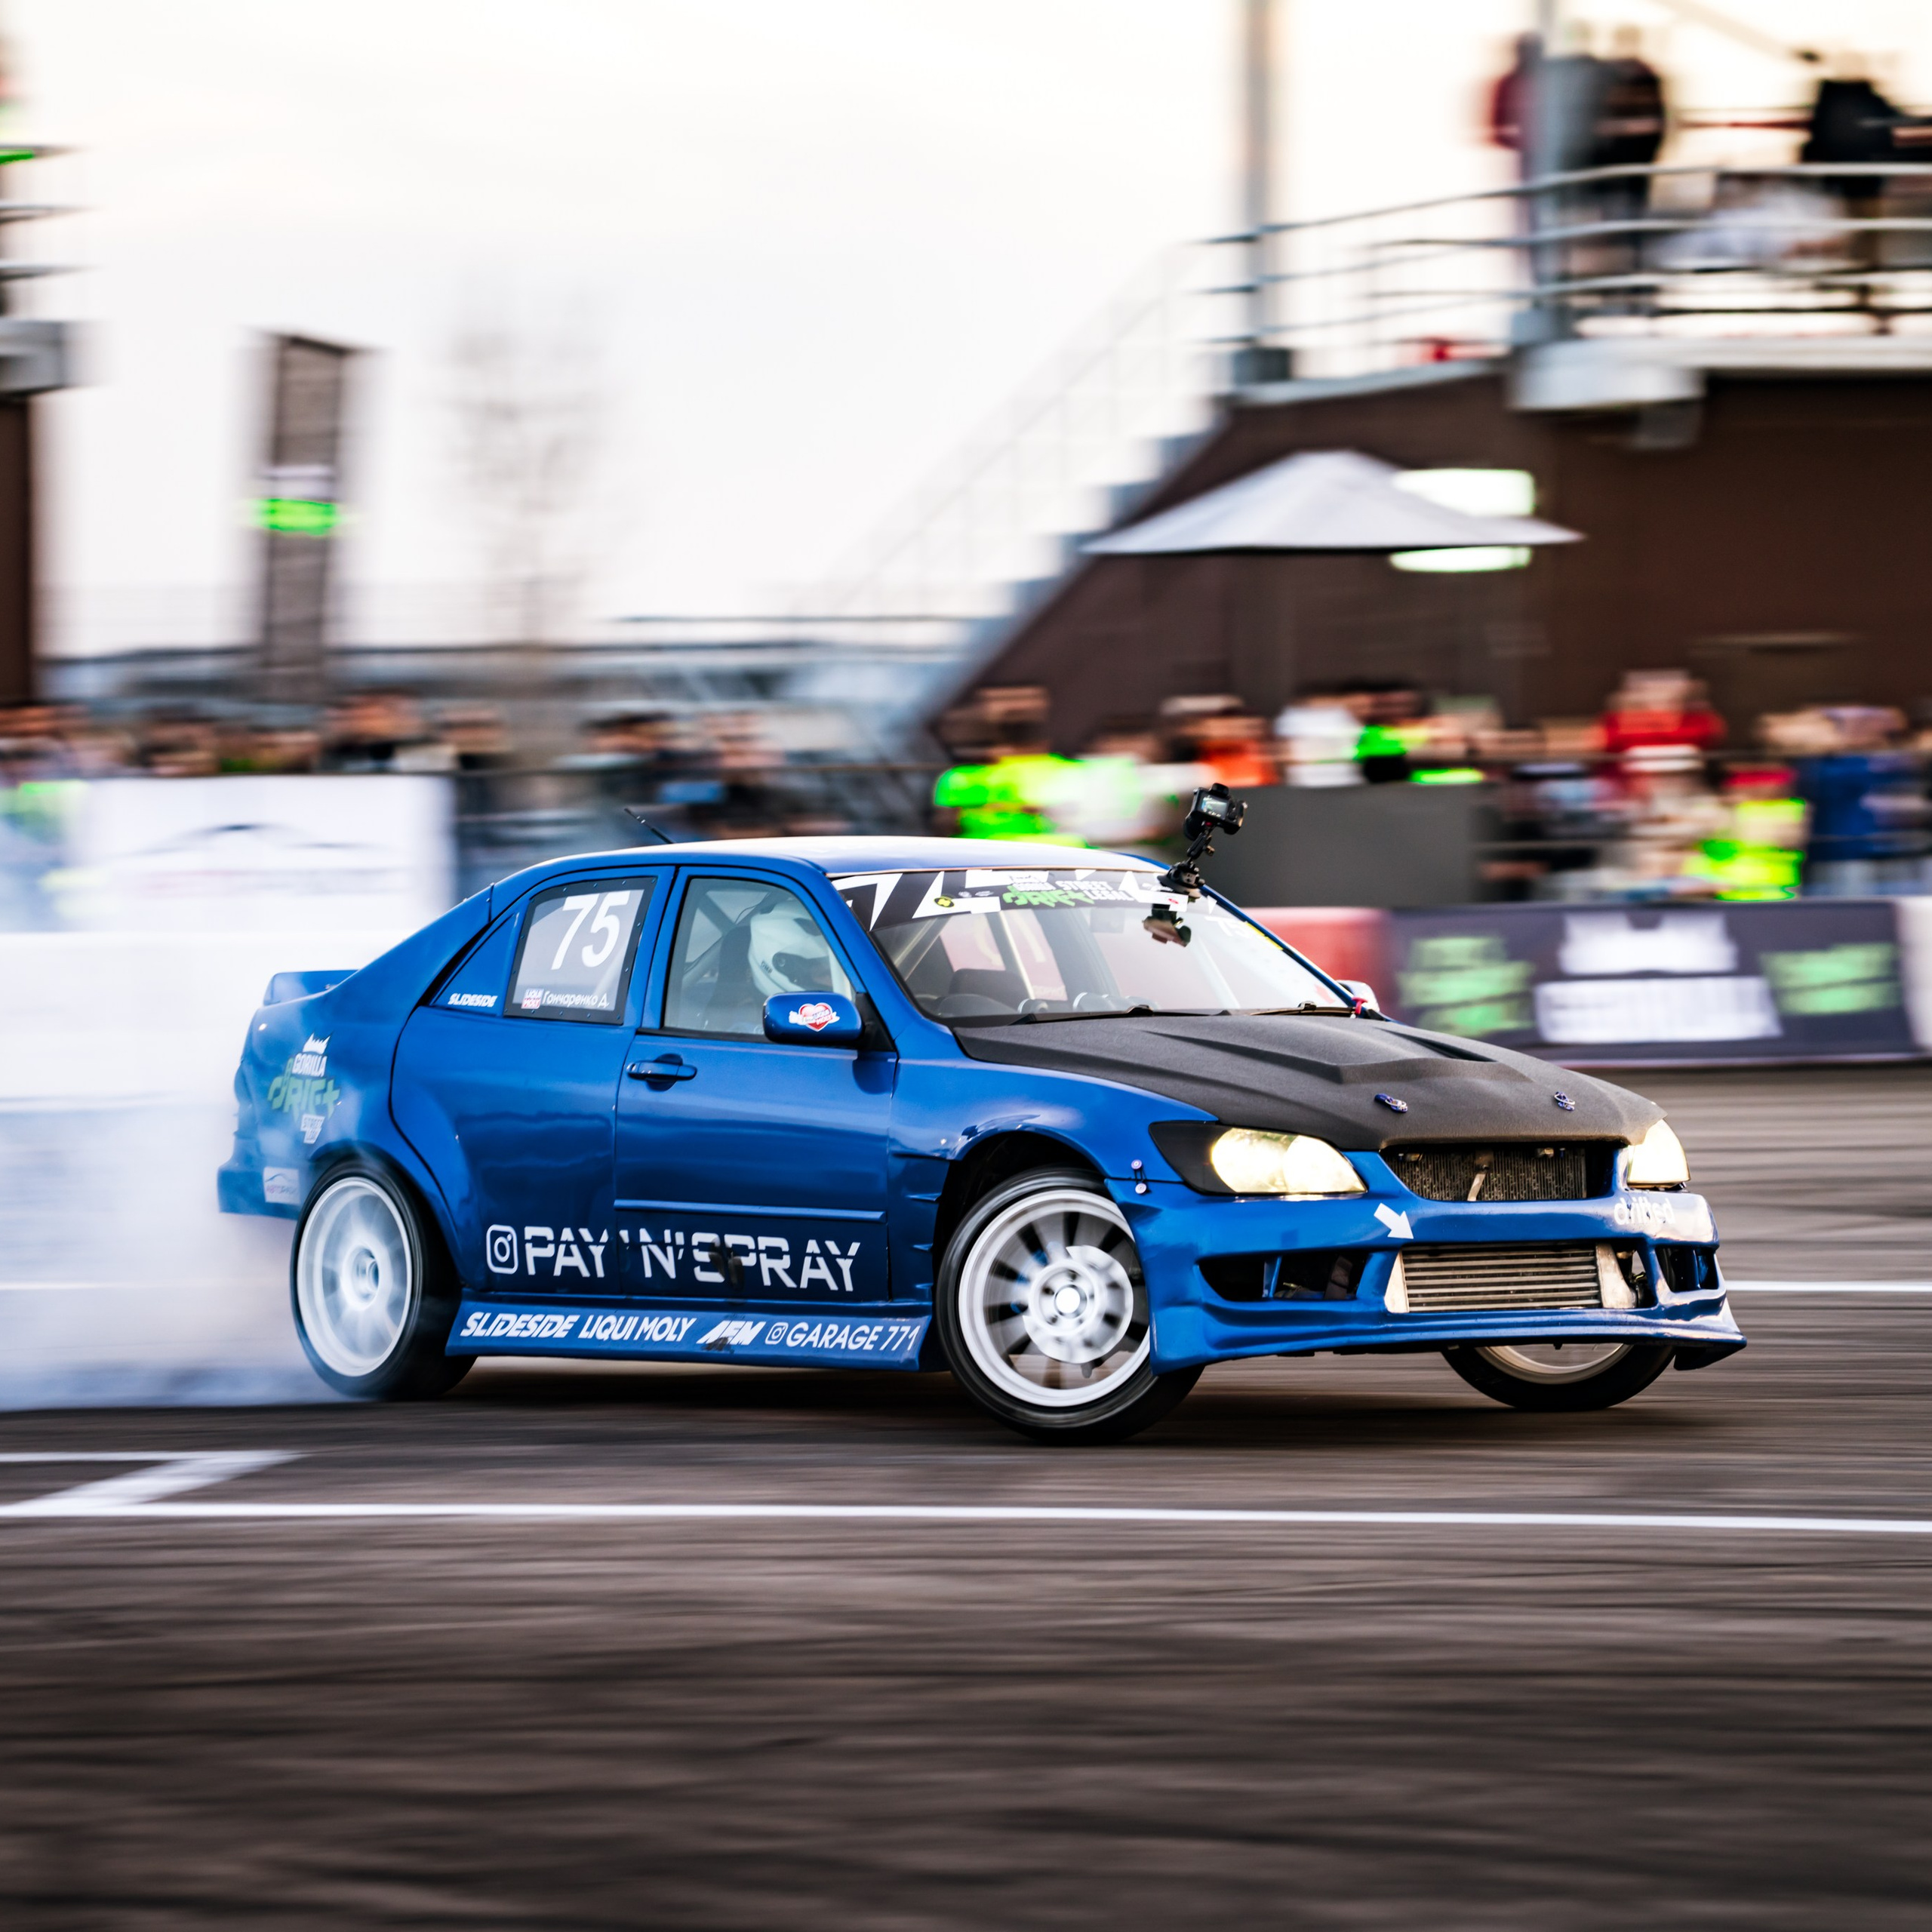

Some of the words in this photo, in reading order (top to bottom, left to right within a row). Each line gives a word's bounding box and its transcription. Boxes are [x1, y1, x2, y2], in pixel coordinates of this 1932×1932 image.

[550, 890, 631, 971] 75
[447, 992, 498, 1008] SLIDESIDE
[542, 990, 598, 1008] Гончаренко
[291, 1053, 328, 1077] GORILLA
[1614, 1197, 1675, 1225] drifted
[524, 1226, 609, 1278] PAY
[460, 1311, 580, 1338] SLIDESIDE
[577, 1314, 639, 1341] LIQUI
[632, 1316, 697, 1342] MOLY
[695, 1320, 767, 1346] AEM
[786, 1321, 884, 1351] GARAGE
[878, 1325, 921, 1351] 771
